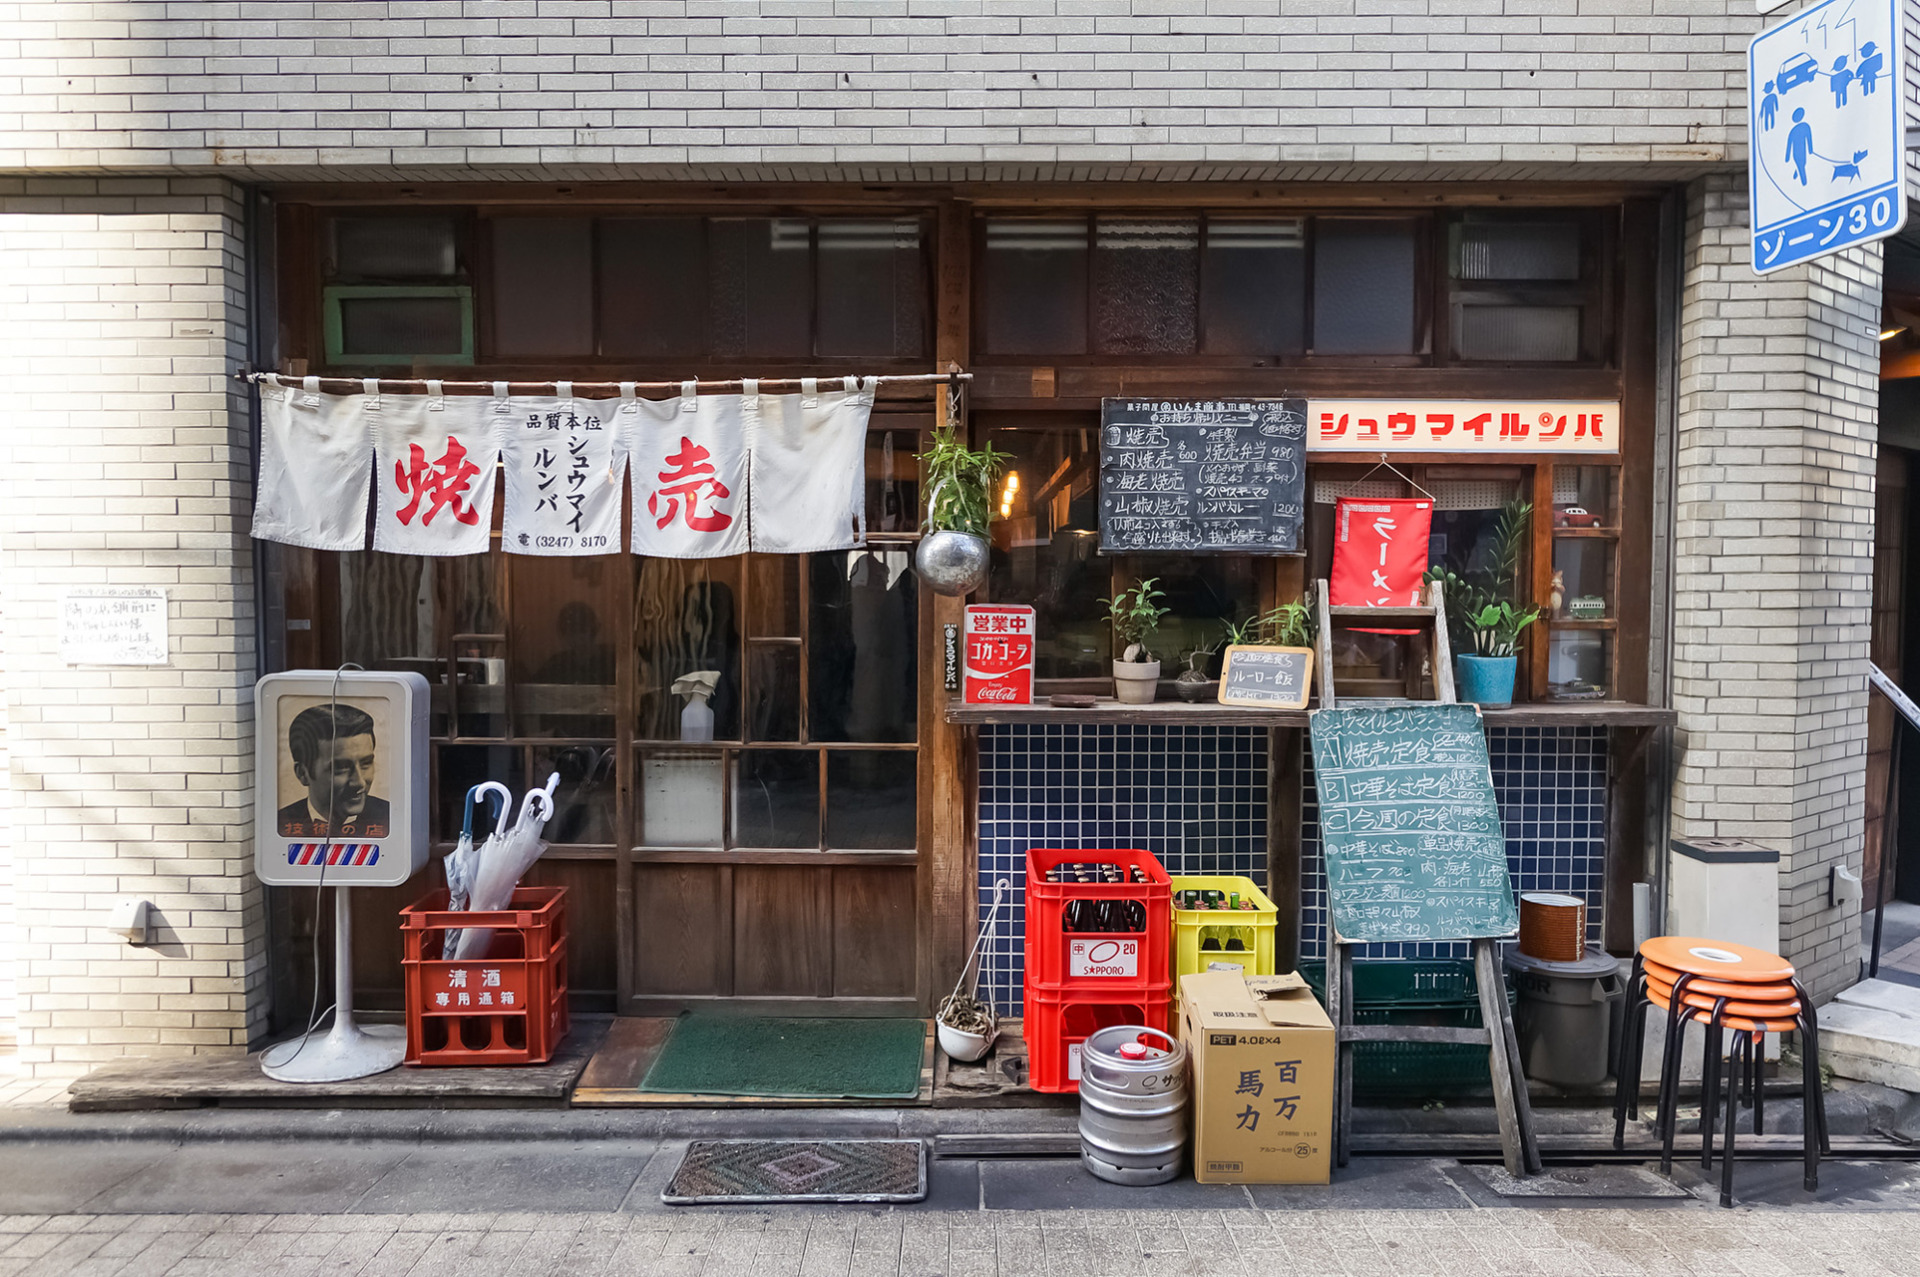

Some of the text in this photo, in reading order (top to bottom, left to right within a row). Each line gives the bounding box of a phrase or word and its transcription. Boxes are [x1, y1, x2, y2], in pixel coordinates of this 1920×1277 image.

[1762, 196, 1891, 265] ゾーン30
[526, 411, 603, 431] 品質本位
[1320, 411, 1604, 443] シュウマイルンバ
[1125, 427, 1162, 445] 焼売
[1206, 427, 1239, 443] 特製
[1119, 449, 1175, 470] 肉焼売
[1179, 450, 1198, 460] 600
[1203, 440, 1294, 462] 焼売弁当 980
[395, 435, 481, 528] 焼
[532, 448, 559, 512] ルンバ
[565, 435, 590, 534] シュウマイ
[647, 435, 733, 533] 売
[1116, 470, 1185, 491] 海老焼売
[1114, 494, 1190, 516] 山椒焼売
[1196, 499, 1261, 514] ルンバカレー
[517, 532, 607, 548] 電 (3247) 8170
[973, 614, 1027, 633] 営業中
[971, 642, 1028, 661] コカ・コーラ
[1233, 669, 1294, 686] ルーロー飯
[1319, 736, 1338, 767] A
[1343, 737, 1434, 768] 焼売定食
[1323, 779, 1341, 801] B
[1350, 772, 1458, 801] 中華そば定食
[1351, 805, 1455, 832] 今週の定食
[284, 822, 385, 837] 技術の店
[1339, 838, 1402, 858] 中華そば
[1339, 866, 1385, 881] ハーフ
[1123, 943, 1136, 955] 20
[448, 968, 501, 988] 清酒
[435, 991, 515, 1007] 専用通箱
[1212, 1035, 1235, 1045] PET
[1273, 1059, 1303, 1121] 百万
[1234, 1069, 1265, 1132] 馬力
[1296, 1145, 1309, 1156] 25
